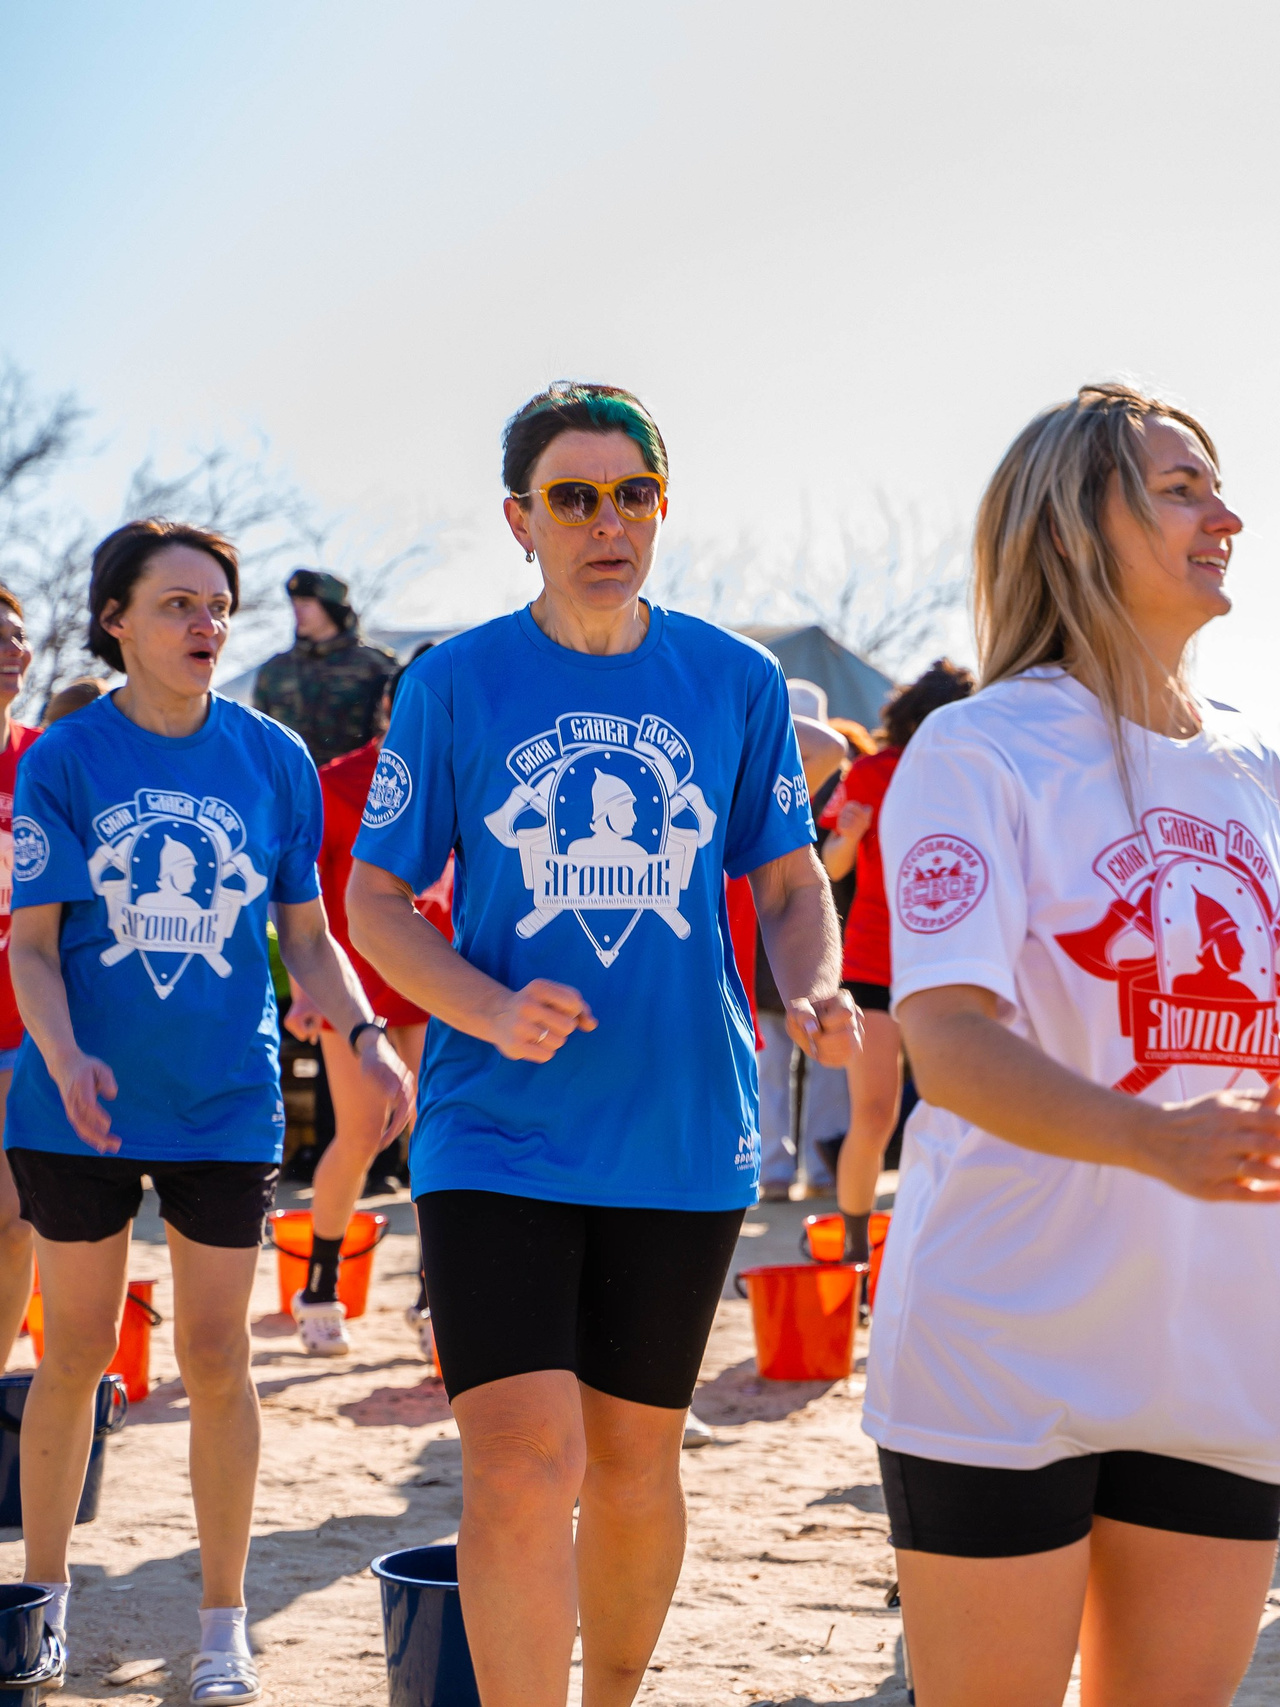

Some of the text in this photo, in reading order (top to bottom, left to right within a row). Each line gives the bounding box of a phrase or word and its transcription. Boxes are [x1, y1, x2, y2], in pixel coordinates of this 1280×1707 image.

[515, 717, 687, 776] СИЛА СЛАВА ДОЛГ
[544, 858, 670, 896] ЯРОПОЛК
[1106, 816, 1273, 886] СИЛА СЛАВА ДОЛГ
